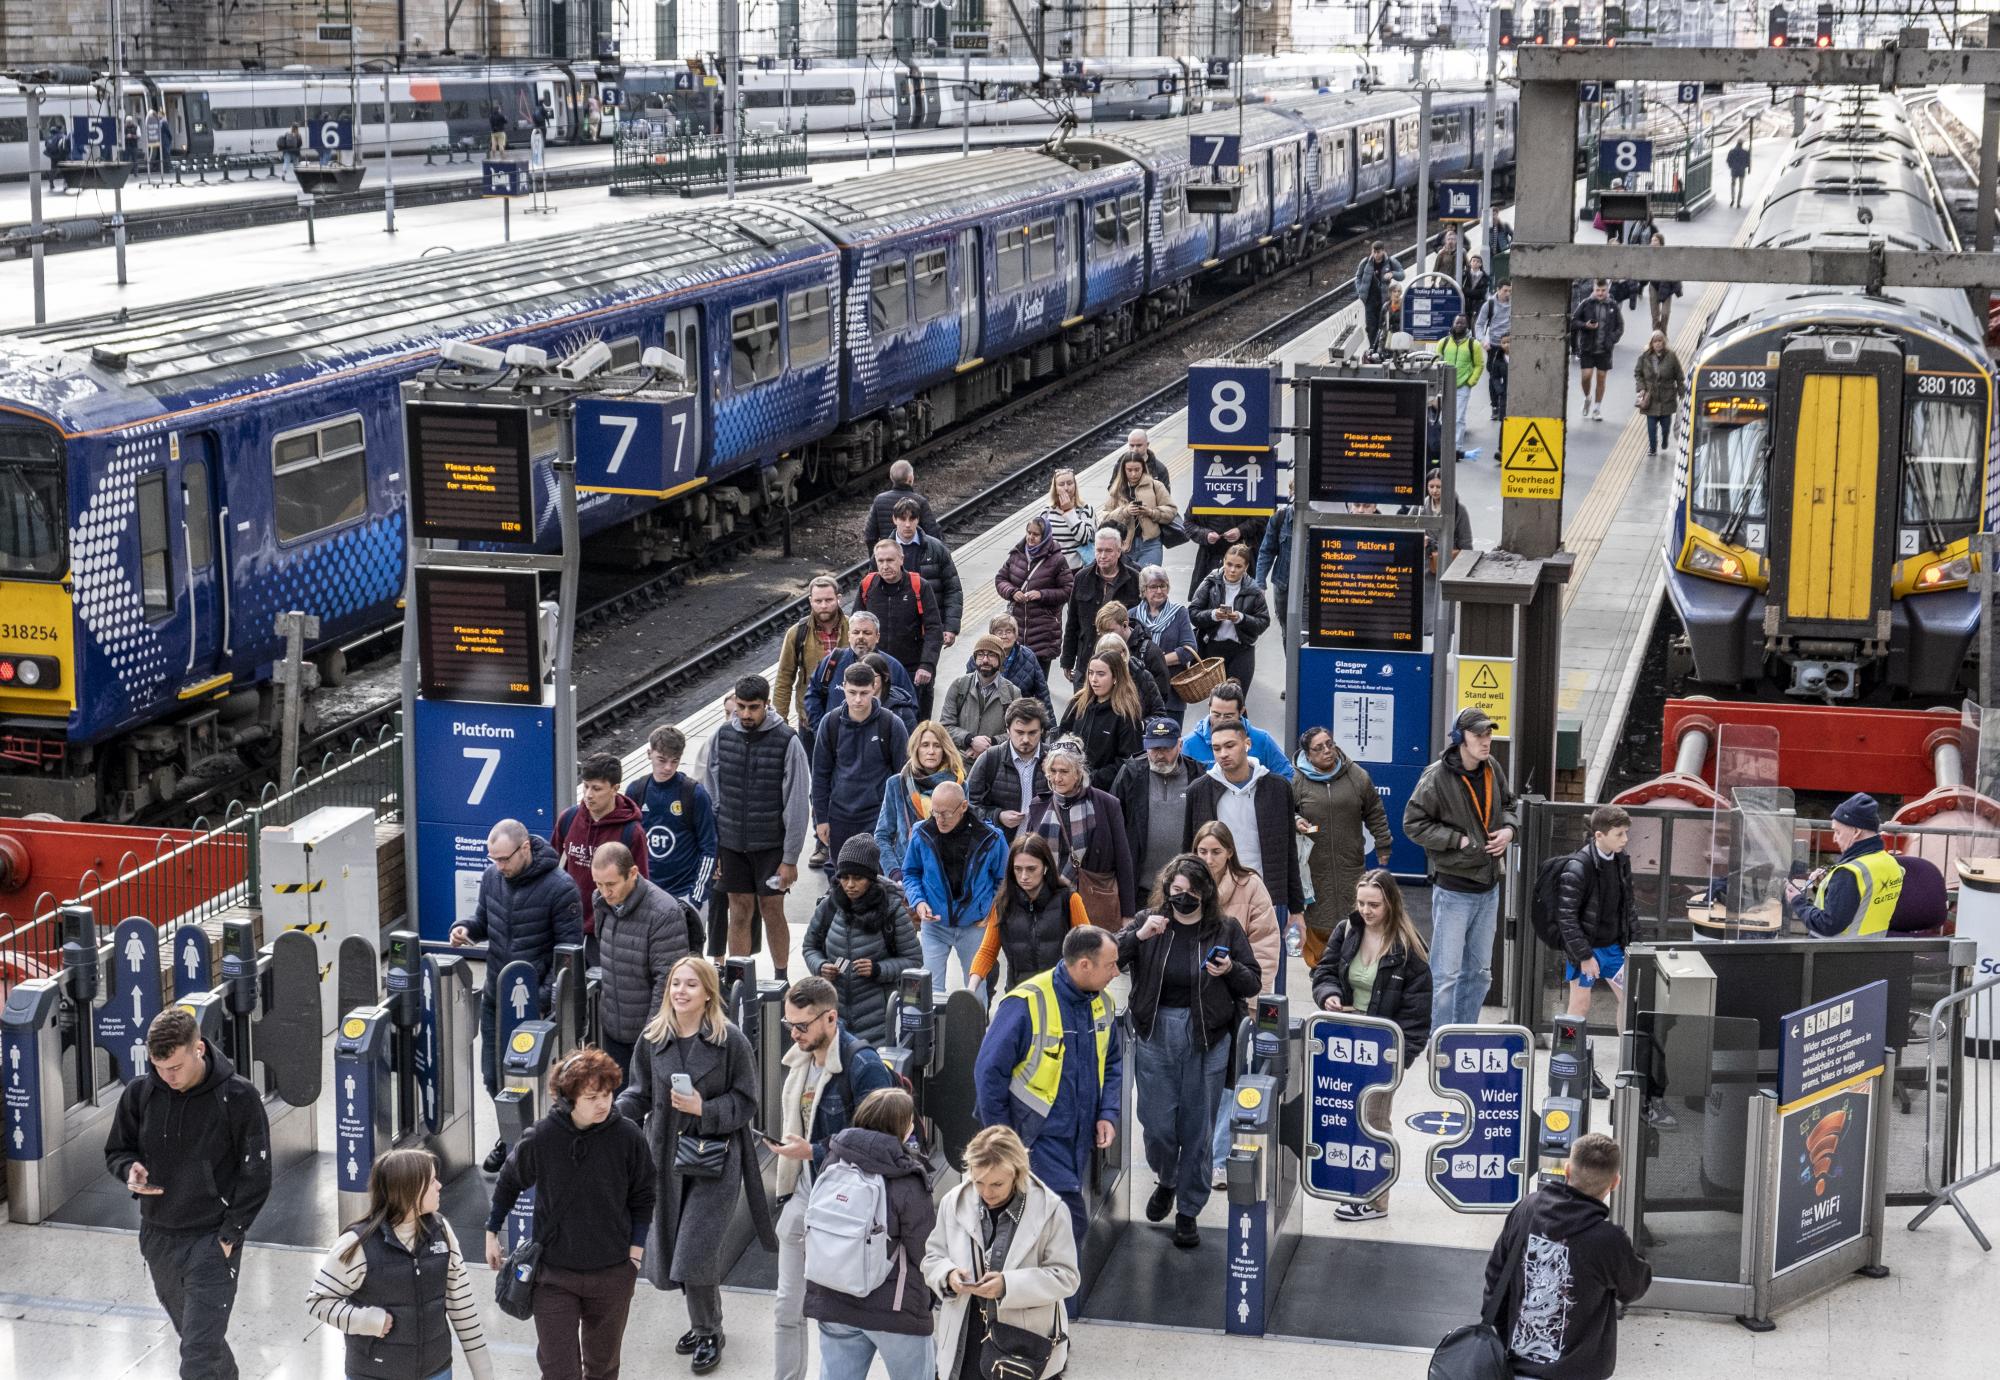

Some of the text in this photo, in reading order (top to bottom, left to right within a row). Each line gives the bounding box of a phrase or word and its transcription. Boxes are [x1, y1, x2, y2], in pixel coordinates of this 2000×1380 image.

[1069, 62, 1078, 74] 5
[1214, 63, 1223, 75] 6
[679, 76, 688, 88] 4
[1087, 80, 1096, 92] 5
[1162, 80, 1172, 93] 6
[606, 90, 615, 104] 3
[1585, 85, 1596, 100] 7
[1682, 86, 1694, 100] 8
[88, 119, 104, 146] 5
[321, 121, 340, 149] 6
[1204, 137, 1225, 165] 7
[1615, 141, 1637, 172] 8
[1709, 372, 1767, 388] 380 103
[1918, 377, 1976, 396] 380 103
[1210, 380, 1247, 433] 8
[600, 415, 638, 474] 7
[671, 413, 687, 472] 7
[445, 463, 496, 473] Please check
[453, 473, 488, 482] timetable
[1508, 475, 1555, 485] Overhead
[447, 482, 496, 491] for services
[1205, 483, 1244, 492] TICKETS
[1508, 485, 1554, 495] live wires
[1751, 529, 1760, 543] 2
[1904, 535, 1914, 549] 2
[1357, 541, 1387, 551] Platform
[2, 624, 58, 641] 318254
[454, 626, 480, 634] Please
[462, 636, 497, 644] timetable
[1335, 661, 1367, 669] Glasgow
[1465, 690, 1487, 699] Stand
[1475, 701, 1493, 709] clear
[453, 722, 515, 739] Platform
[463, 747, 501, 805] 7
[568, 841, 587, 854] Jack
[651, 834, 669, 848] BT
[1804, 1029, 1852, 1053] Wider access gate
[1803, 1032, 1872, 1066] available for customers in
[1803, 1059, 1835, 1078] wheelchairs
[1843, 1050, 1855, 1061] with
[1821, 1071, 1835, 1082] bikes
[1836, 1068, 1842, 1076] or
[1844, 1059, 1865, 1075] luggage
[1317, 1075, 1353, 1092] Wider
[1315, 1095, 1354, 1110] access
[1481, 1089, 1518, 1102] Wider
[1321, 1113, 1347, 1127] gate
[1478, 1108, 1519, 1120] access
[1484, 1125, 1512, 1140] gate
[1802, 1207, 1813, 1218] Fast
[1814, 1194, 1840, 1222] WiFi
[1801, 1218, 1812, 1228] Free
[1231, 1264, 1245, 1272] keep
[1235, 1257, 1254, 1265] Please
